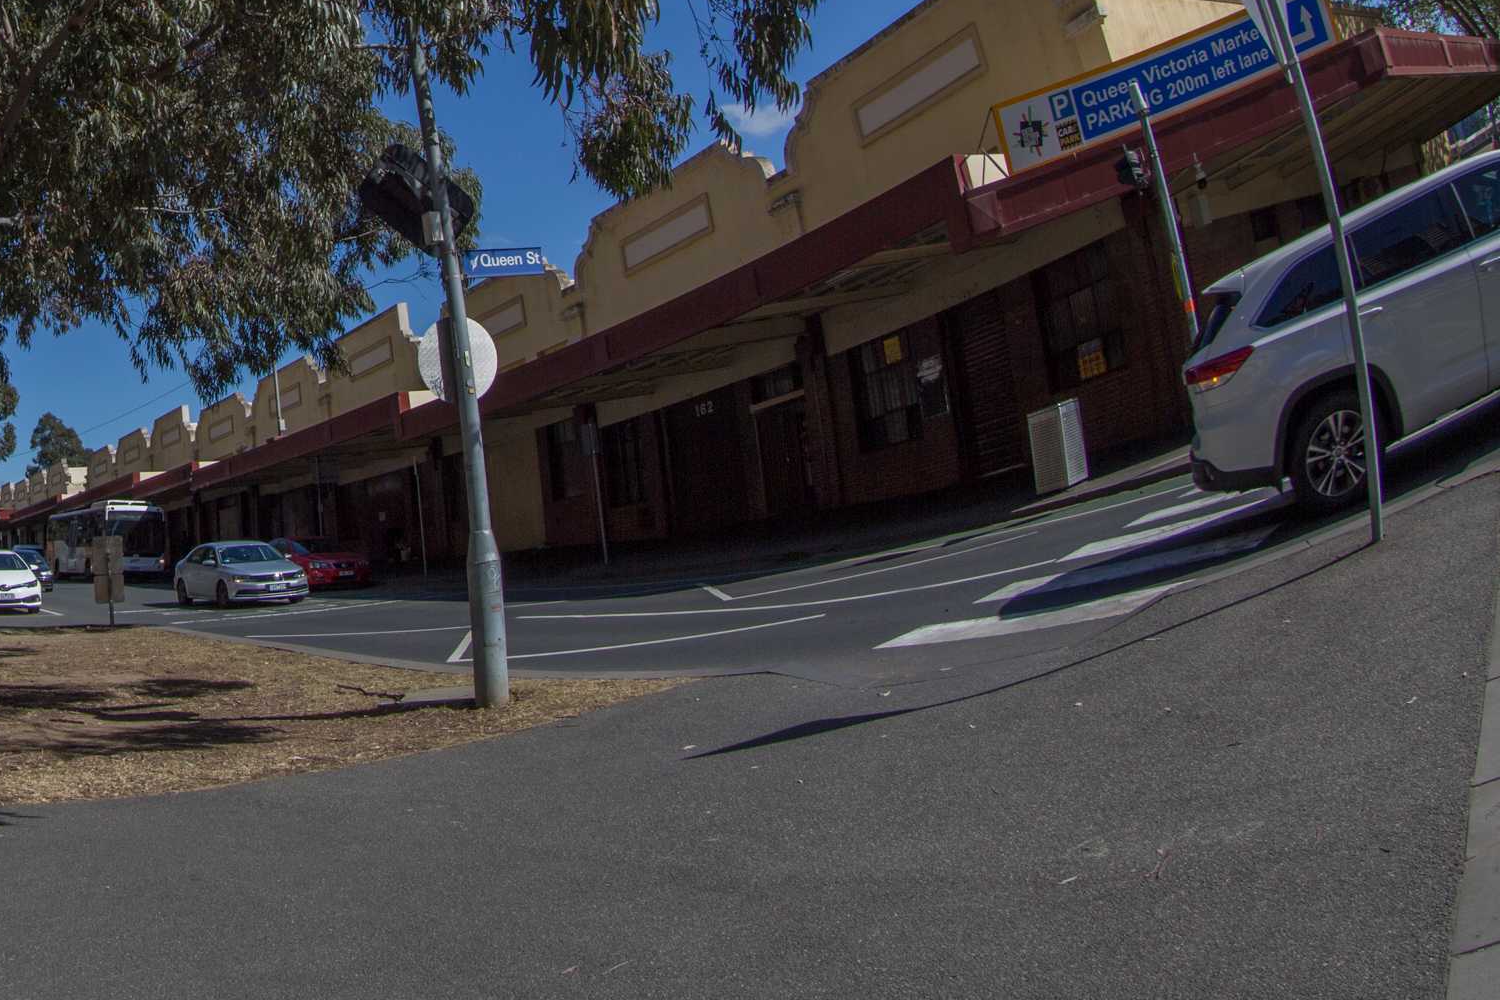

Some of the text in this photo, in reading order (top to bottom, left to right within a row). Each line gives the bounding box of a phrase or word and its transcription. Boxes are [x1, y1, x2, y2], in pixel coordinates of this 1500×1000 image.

[1142, 50, 1209, 83] Victoria
[1210, 27, 1260, 57] Marke
[1052, 94, 1068, 119] P
[1086, 47, 1270, 131] PARKG 200m left lane
[480, 251, 541, 267] Queen St
